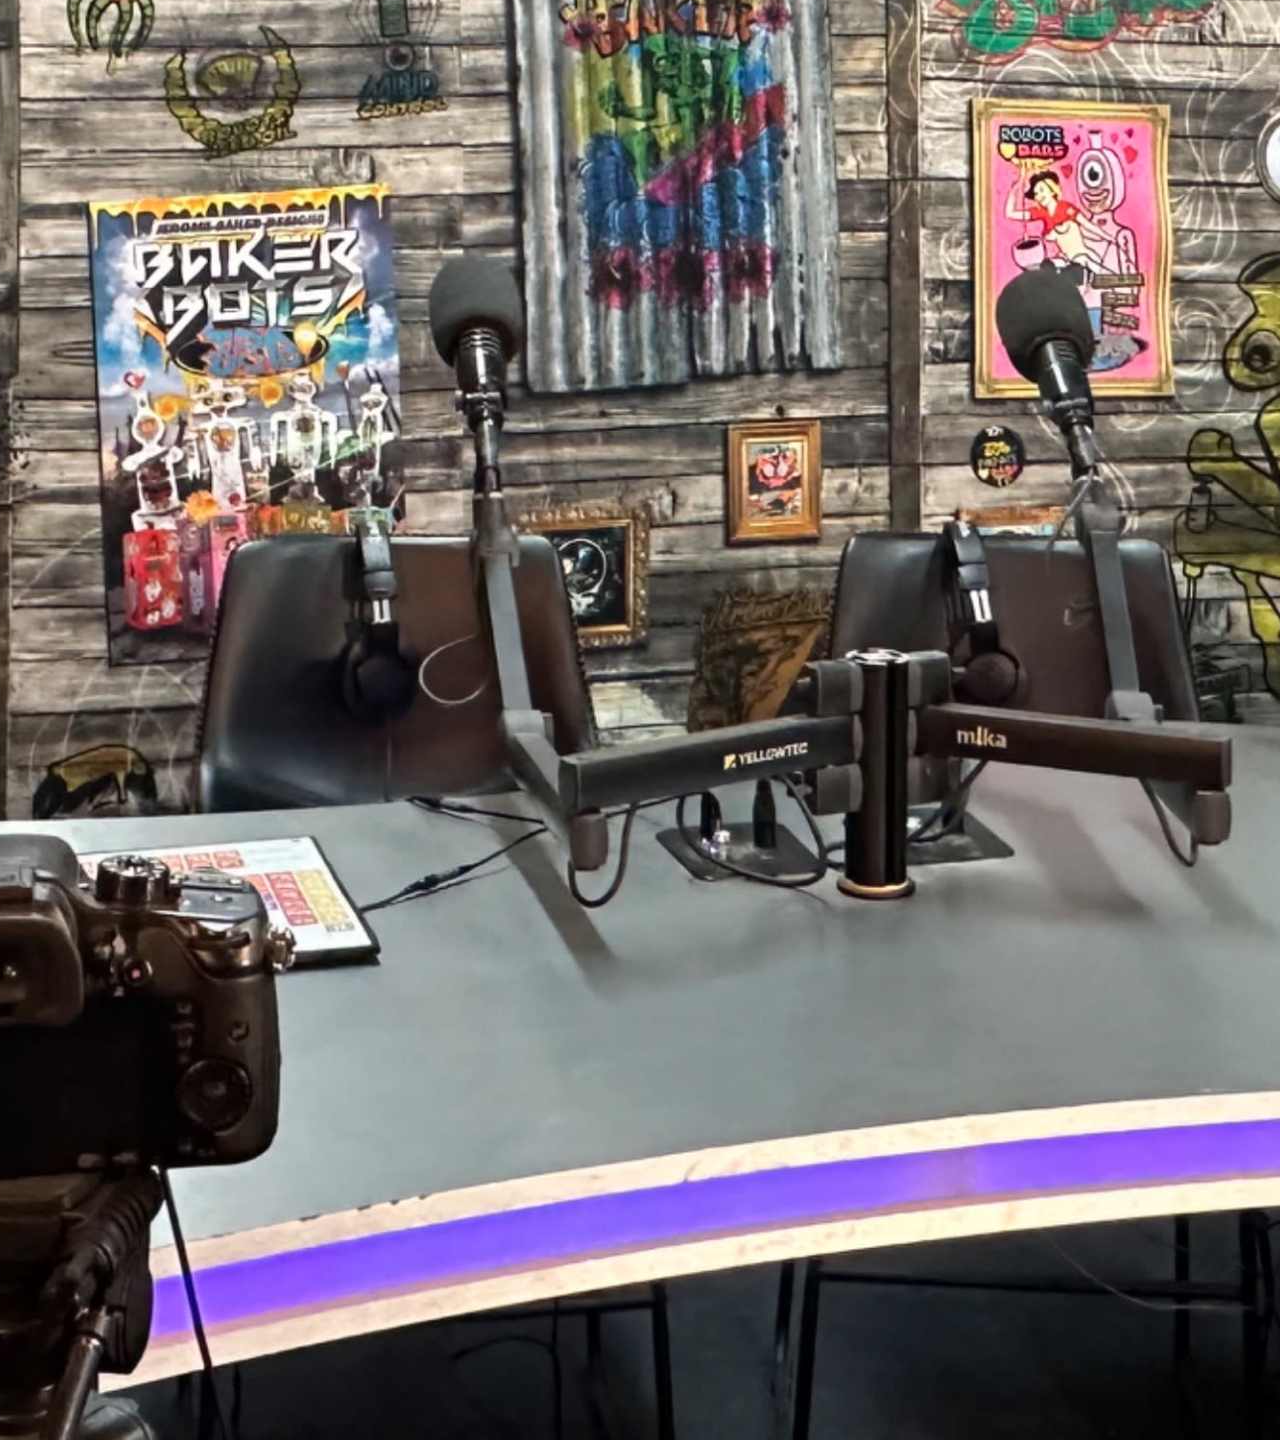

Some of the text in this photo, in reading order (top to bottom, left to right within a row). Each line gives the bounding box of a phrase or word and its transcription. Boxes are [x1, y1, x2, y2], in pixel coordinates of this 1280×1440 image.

[1001, 127, 1062, 142] ROBOTS
[131, 230, 364, 288] BAKER
[161, 275, 337, 344] BOTS
[956, 725, 1008, 749] mika
[738, 742, 809, 766] YELLOWTEC
